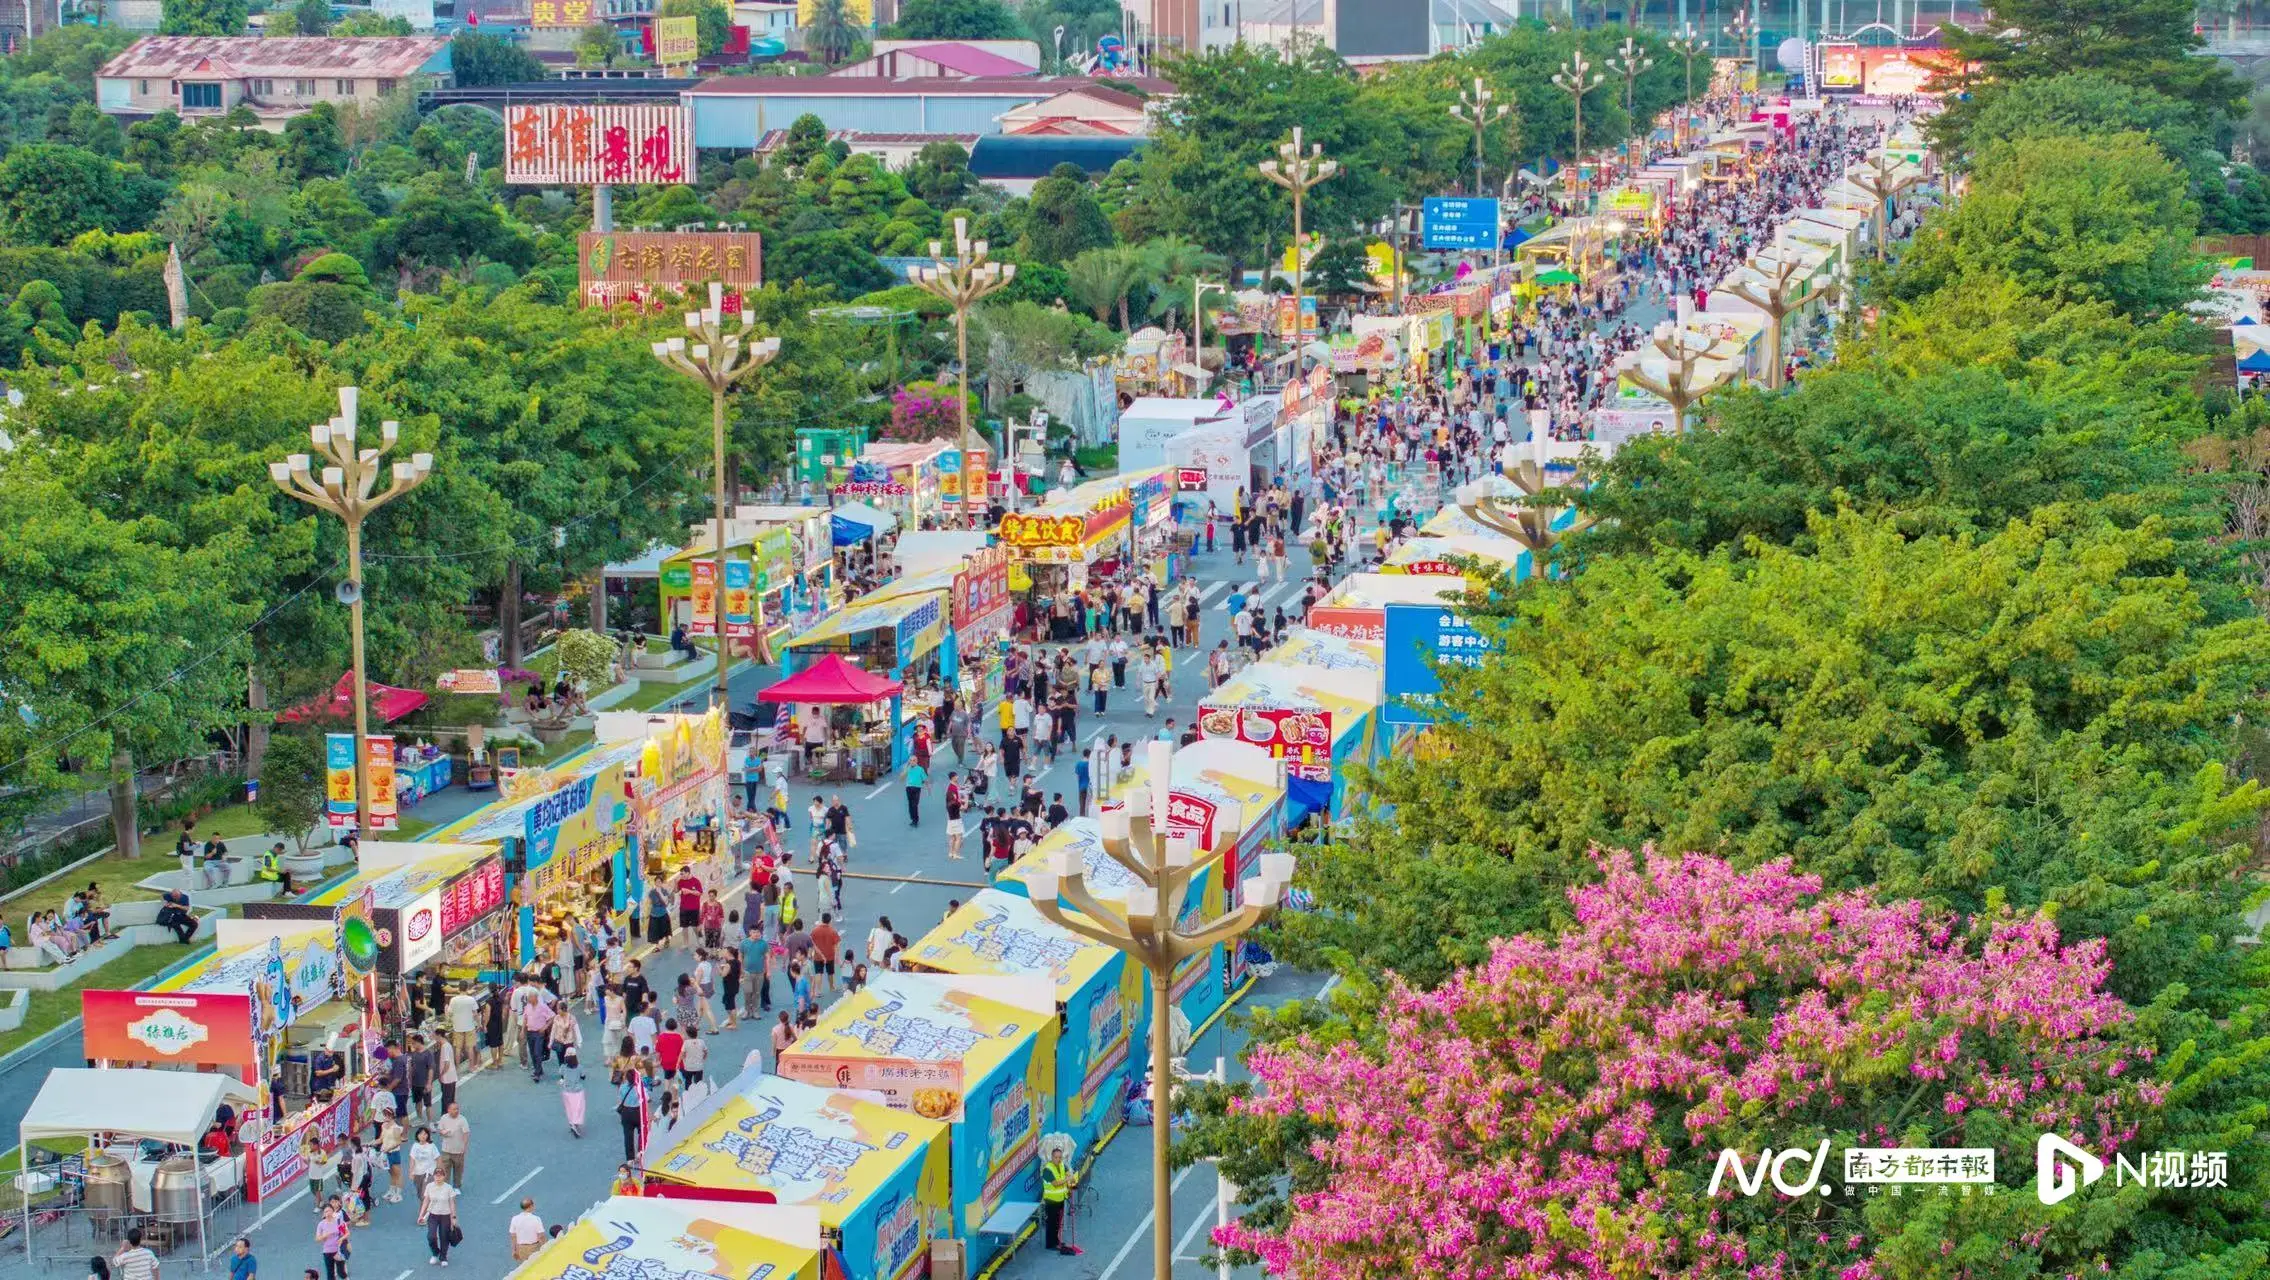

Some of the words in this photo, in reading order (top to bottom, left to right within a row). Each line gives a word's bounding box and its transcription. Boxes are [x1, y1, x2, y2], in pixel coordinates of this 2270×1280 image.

[511, 106, 682, 181] 东信景观
[1438, 634, 1490, 648] 游客中心
[1169, 799, 1207, 826] 食品
